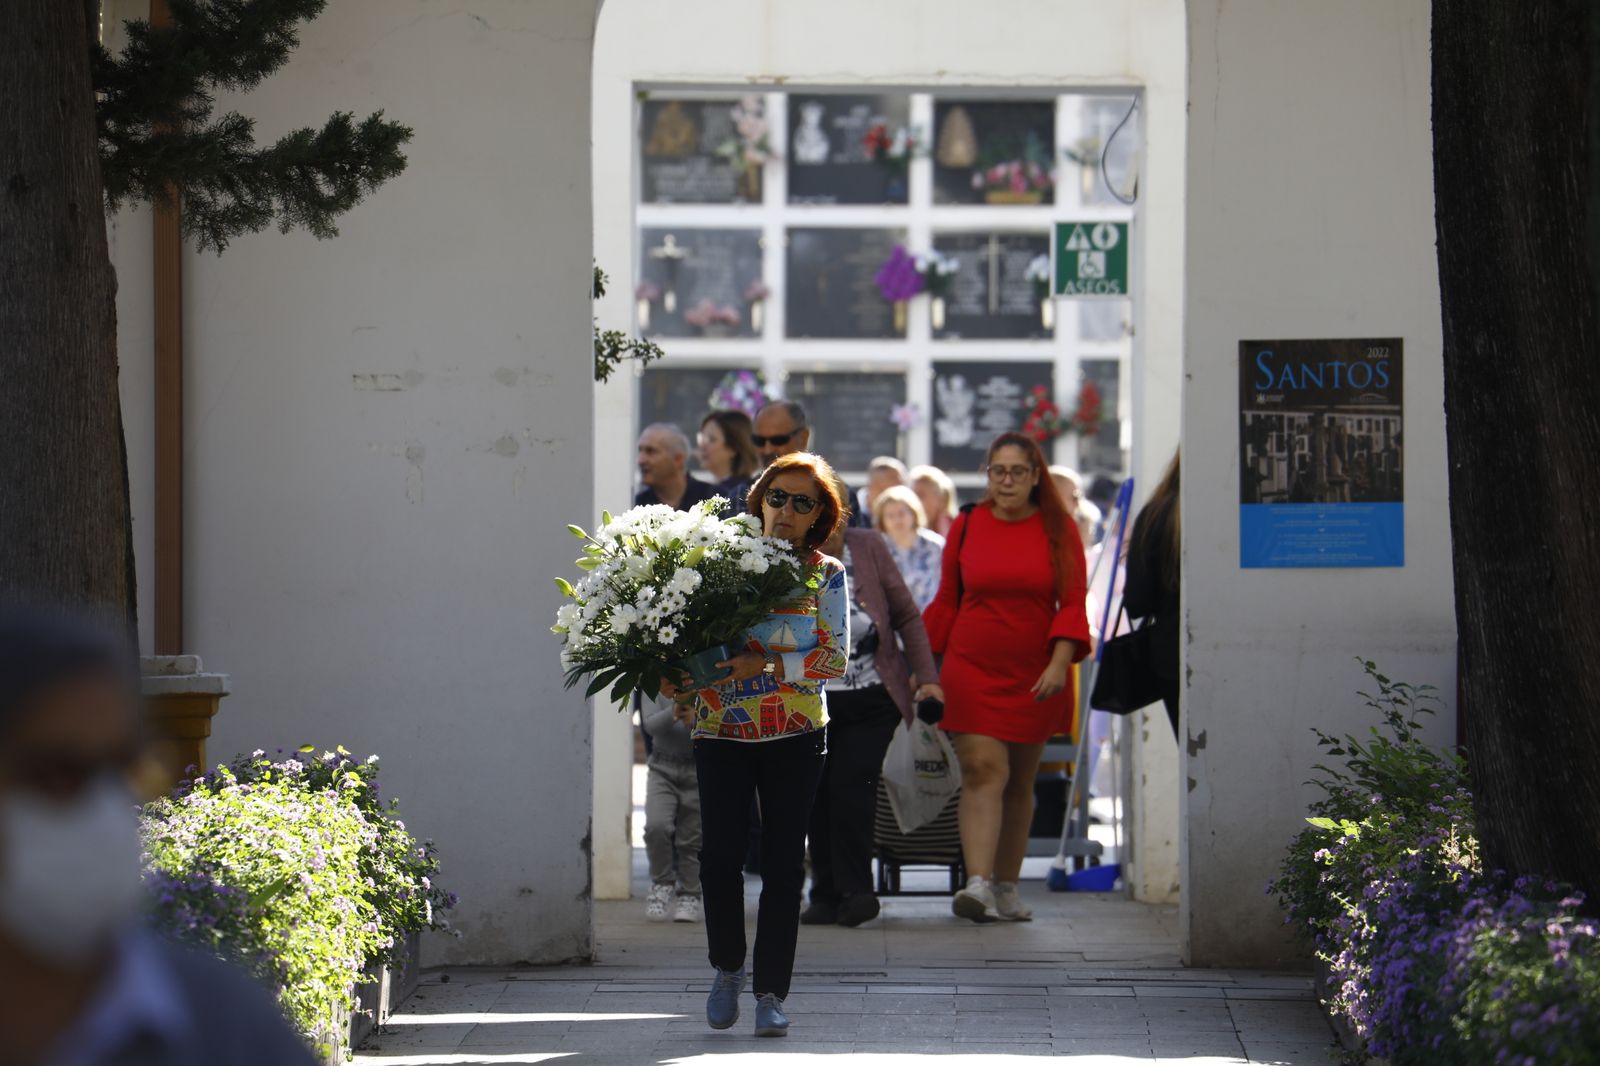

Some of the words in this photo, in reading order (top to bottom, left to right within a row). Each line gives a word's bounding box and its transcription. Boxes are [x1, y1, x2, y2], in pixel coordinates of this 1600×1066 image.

[1064, 279, 1120, 295] ASEOS
[1367, 346, 1390, 359] 2022
[1256, 350, 1390, 390] SANTOS
